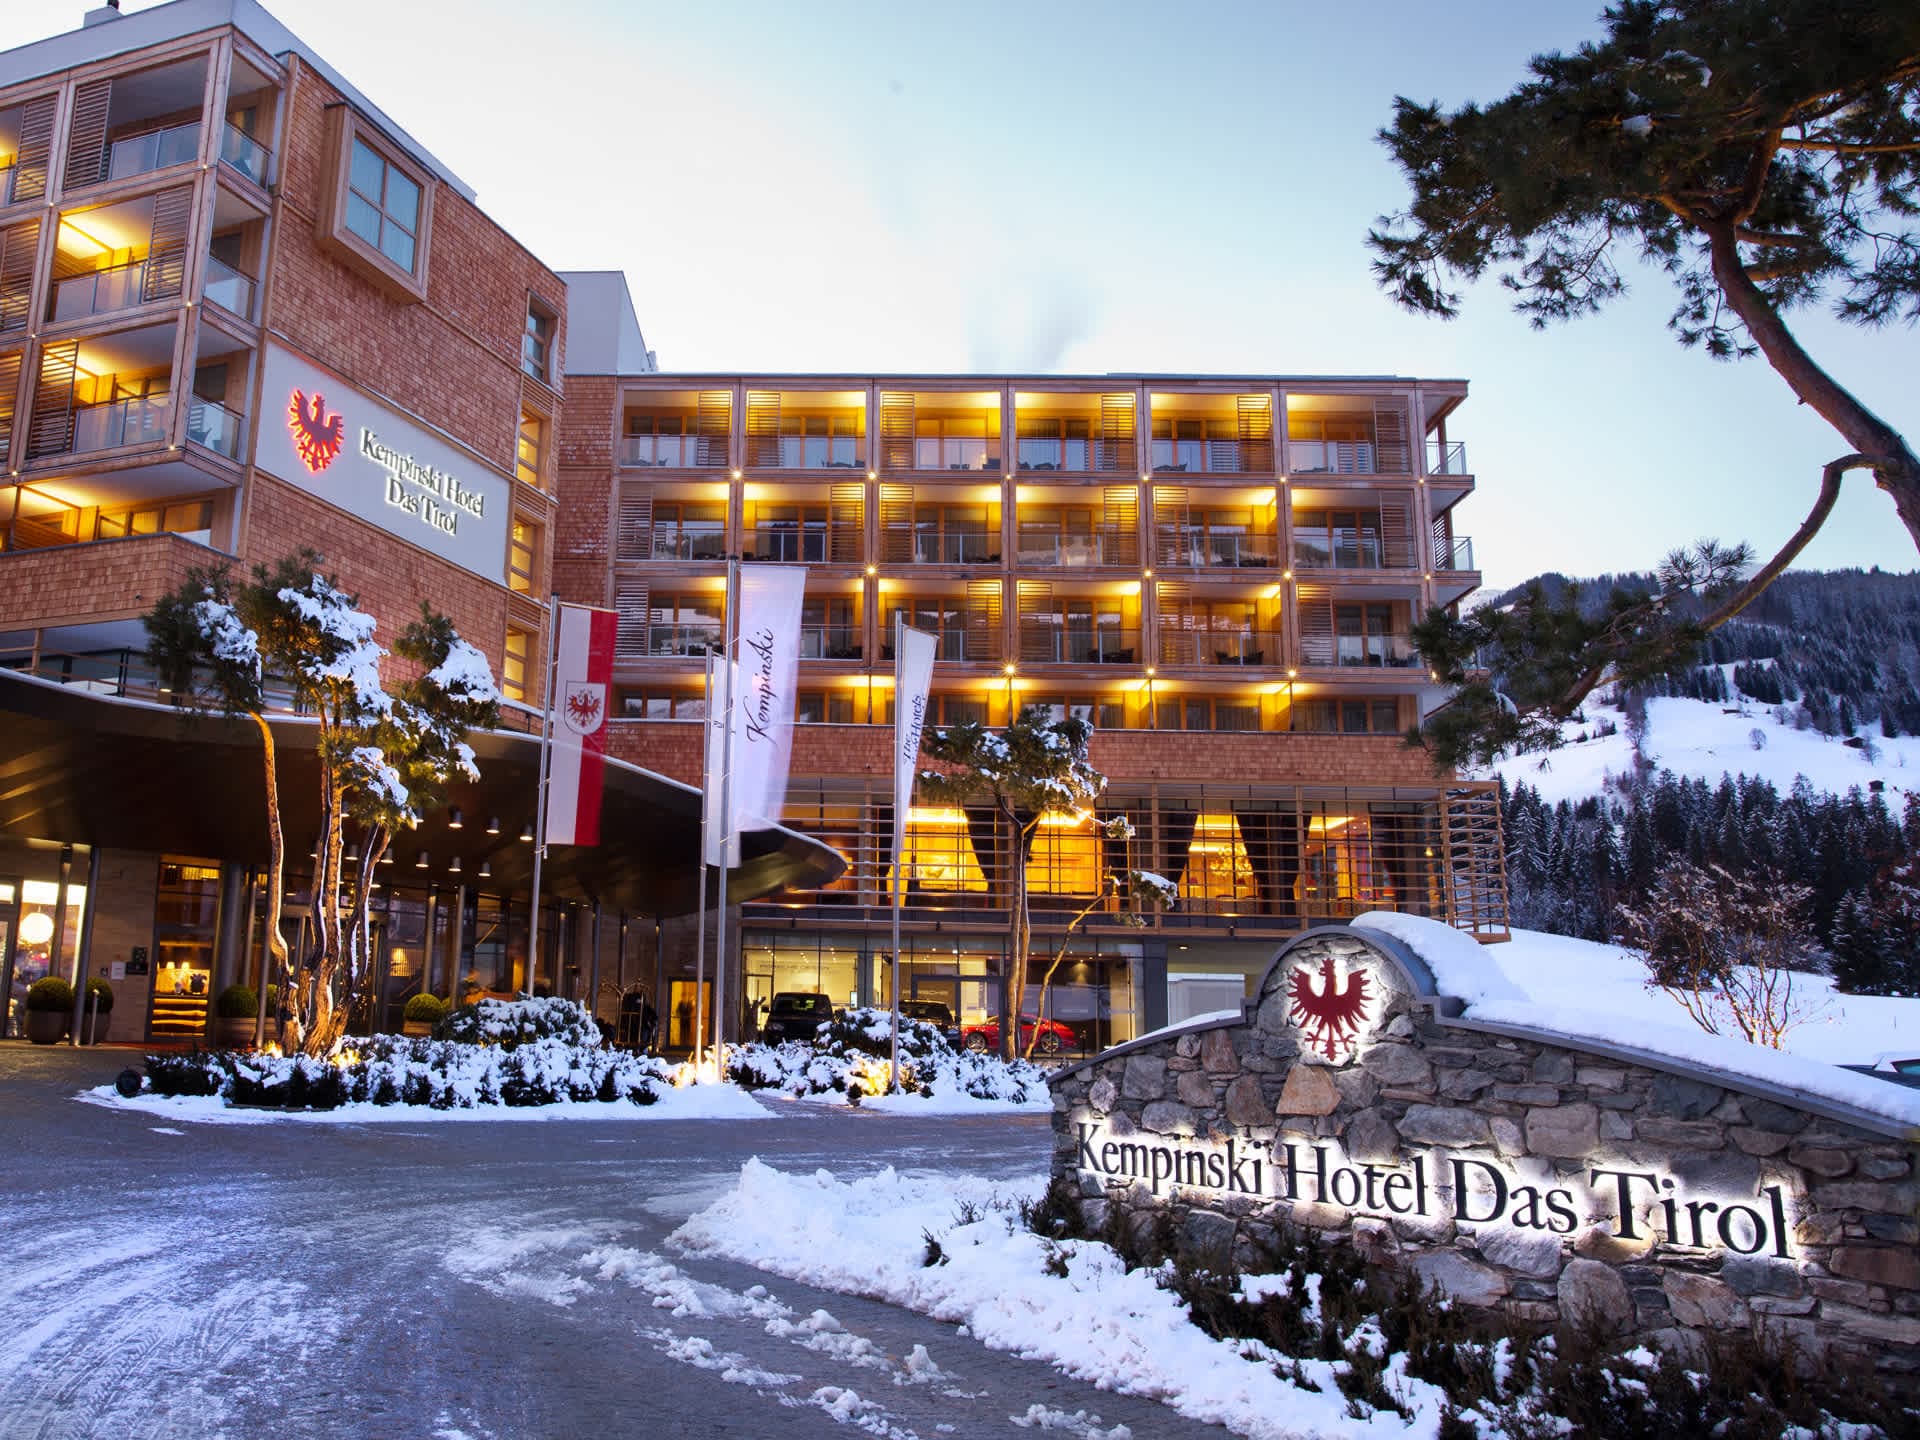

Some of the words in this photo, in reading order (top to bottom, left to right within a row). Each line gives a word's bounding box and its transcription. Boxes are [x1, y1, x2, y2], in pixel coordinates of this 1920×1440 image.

[361, 429, 442, 494] Kempinski
[447, 477, 485, 517] Hotel
[388, 479, 419, 514] Das
[421, 495, 458, 535] Tirol
[743, 628, 780, 751] Kempinski
[1077, 1122, 1263, 1195] Kempinski
[1283, 1143, 1430, 1216] Hotel
[1448, 1158, 1578, 1233] Das
[1591, 1168, 1796, 1260] Tirol
